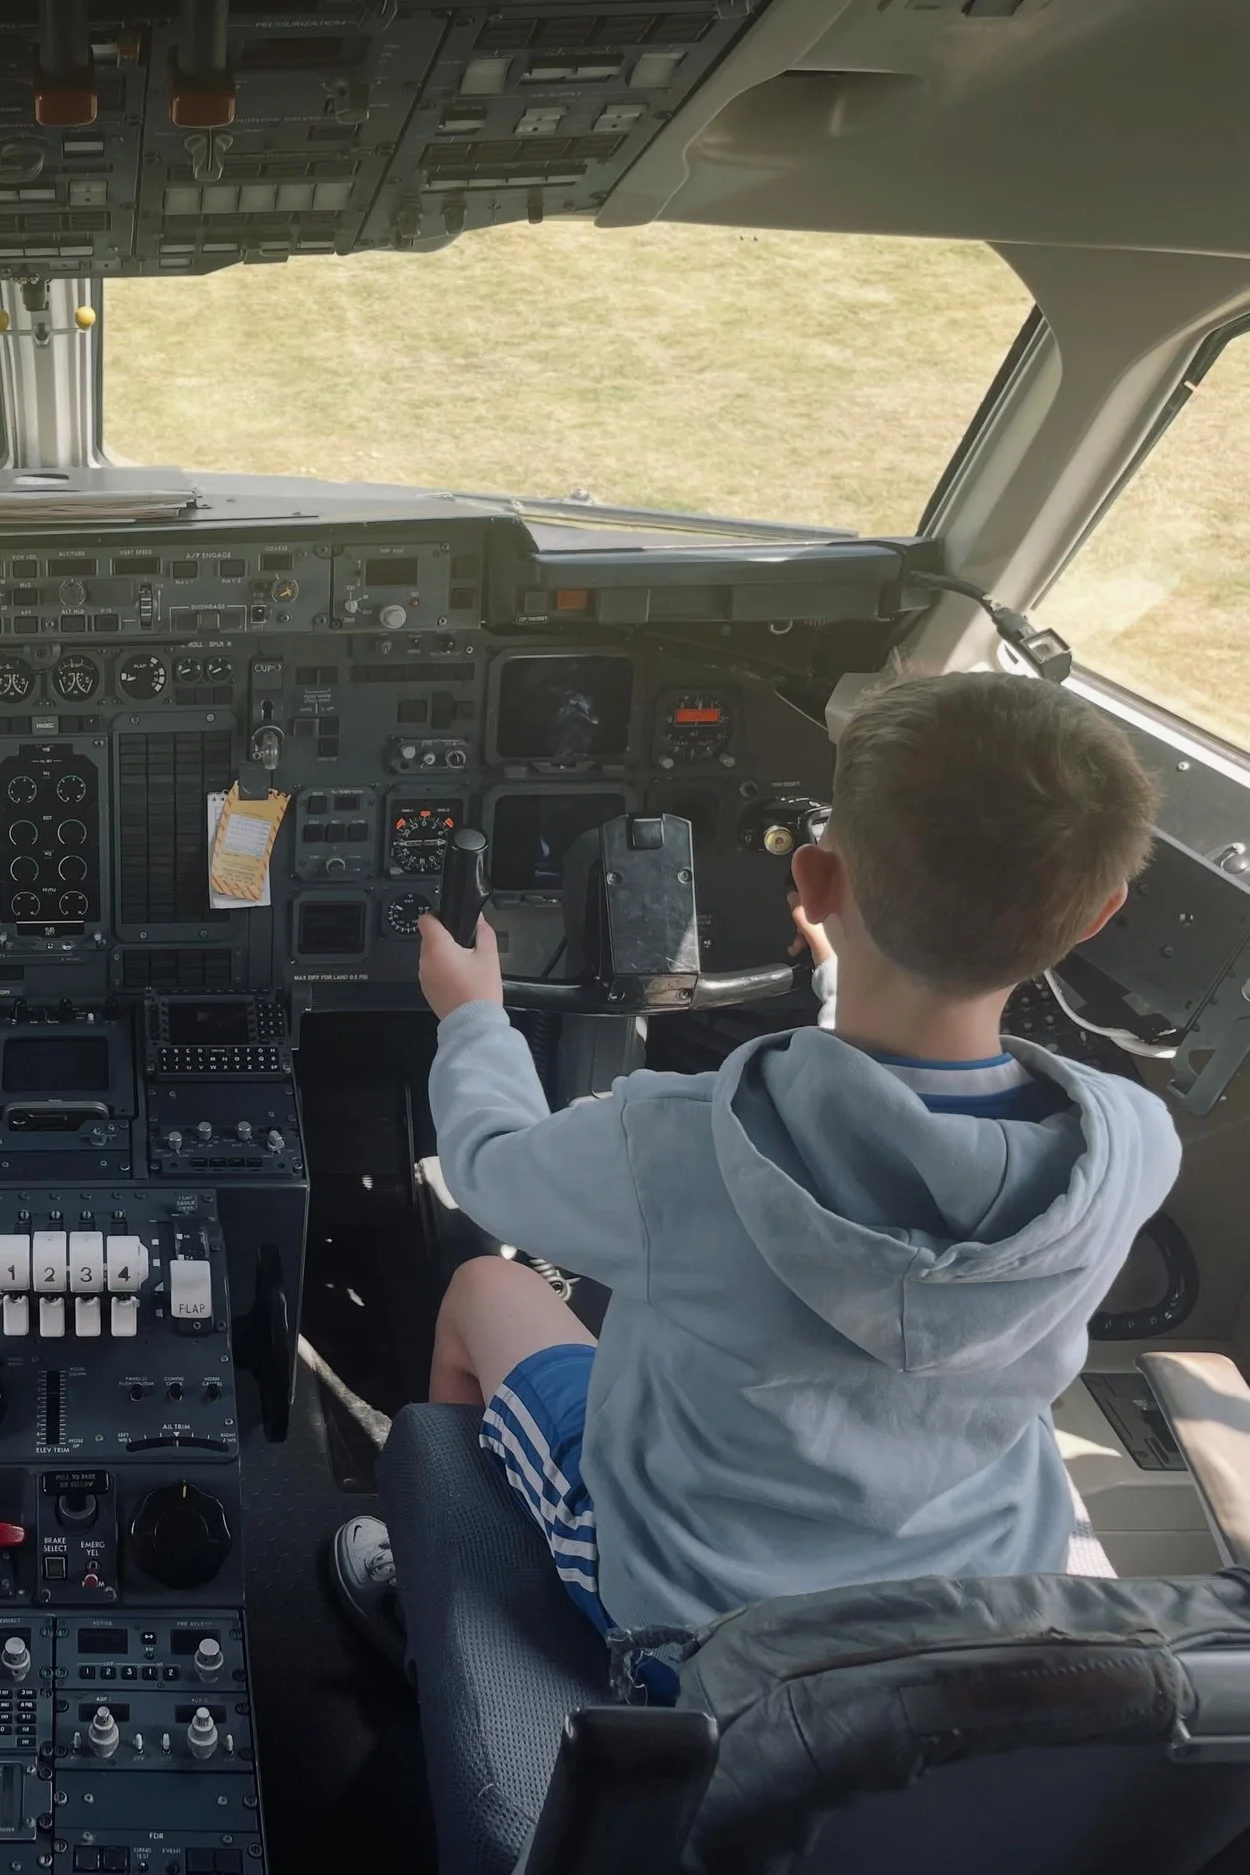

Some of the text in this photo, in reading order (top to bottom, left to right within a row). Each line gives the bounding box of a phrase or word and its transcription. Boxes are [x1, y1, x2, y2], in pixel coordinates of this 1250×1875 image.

[255, 19, 347, 28] PRESSURIZATION
[264, 544, 289, 552] COURSE
[202, 551, 232, 559] ENGAGE
[190, 603, 226, 611] DISENGAGE
[7, 1264, 16, 1281] 1
[43, 1266, 56, 1283] 2
[79, 1266, 93, 1283] 3
[117, 1265, 131, 1282] 4
[178, 1303, 206, 1314] FLAP
[161, 1423, 191, 1431] AIL TRIM
[80, 1473, 96, 1481] PARK
[43, 1536, 67, 1545] BRAKE
[80, 1540, 106, 1549] EMERG
[42, 1544, 68, 1553] SELECT
[86, 1548, 99, 1557] YEL
[148, 1831, 165, 1840] FDR
[161, 1847, 182, 1855] EVENT
[135, 1852, 151, 1860] TEST
